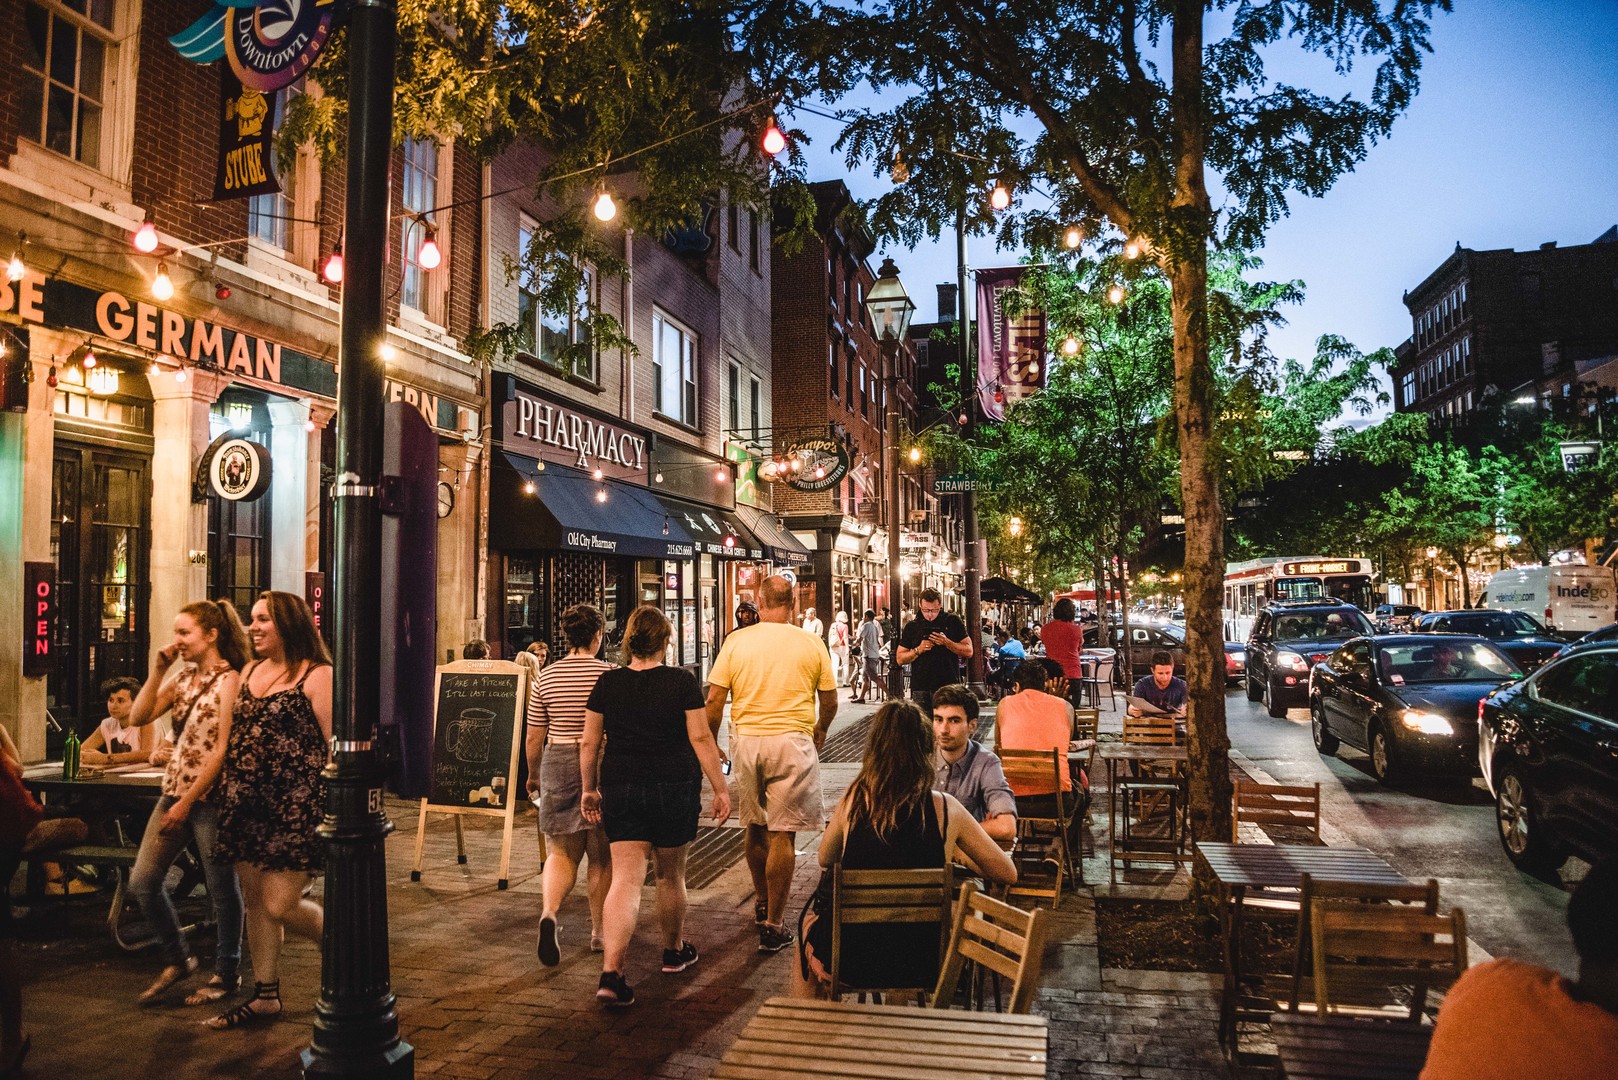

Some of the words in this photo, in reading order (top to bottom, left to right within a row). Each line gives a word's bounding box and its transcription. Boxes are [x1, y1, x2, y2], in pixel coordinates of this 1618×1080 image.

[239, 13, 309, 69] Downtown
[225, 142, 267, 190] STUBE
[96, 291, 281, 384] GERMAN
[517, 396, 645, 469] PHARMACY
[934, 480, 993, 491] STRAWBERRY
[191, 553, 206, 564] 206
[567, 532, 579, 546] Old
[579, 533, 591, 550] City
[591, 534, 617, 552] Pharmacy
[1288, 564, 1296, 575] 5
[36, 582, 50, 655] OPEN
[445, 676, 469, 688] TAKE
[472, 679, 479, 687] A
